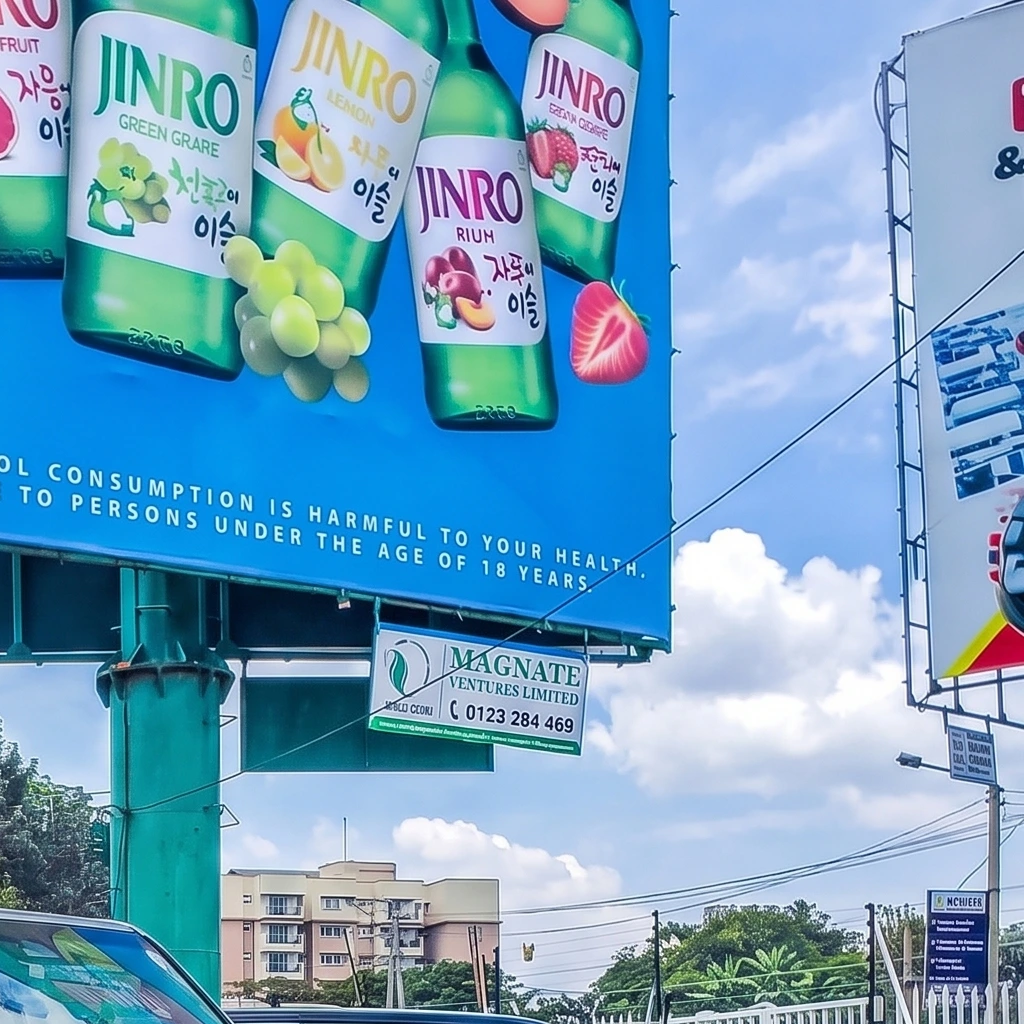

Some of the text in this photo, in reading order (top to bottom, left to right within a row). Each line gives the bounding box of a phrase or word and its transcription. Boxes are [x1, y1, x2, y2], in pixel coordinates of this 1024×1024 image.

[93, 34, 239, 136] JINRO
[291, 10, 417, 124] JINRO
[536, 49, 626, 129] JINRO
[119, 113, 168, 142] GREEN
[327, 88, 375, 129] LEMON
[353, 178, 391, 224] 이슬
[416, 166, 523, 234] JINRO
[592, 177, 617, 213] 이슬
[508, 283, 540, 329] 이슬
[19, 485, 53, 508] TO
[71, 493, 198, 529] PERSONS
[214, 516, 302, 546] UNDER
[317, 532, 362, 555] THE
[378, 544, 424, 565] AGE
[438, 552, 467, 572] OF
[481, 560, 507, 578] 18
[48, 463, 254, 512] CONSUMPTION
[269, 498, 293, 518] IS
[309, 505, 427, 541] HARMFUL
[440, 527, 469, 548] TO
[482, 534, 543, 561] YOUR
[556, 547, 646, 579] HEALTH.
[449, 646, 581, 688] MAGNATE
[449, 676, 580, 706] VENTURES LIMITED
[465, 704, 575, 734] 0123 284 469
